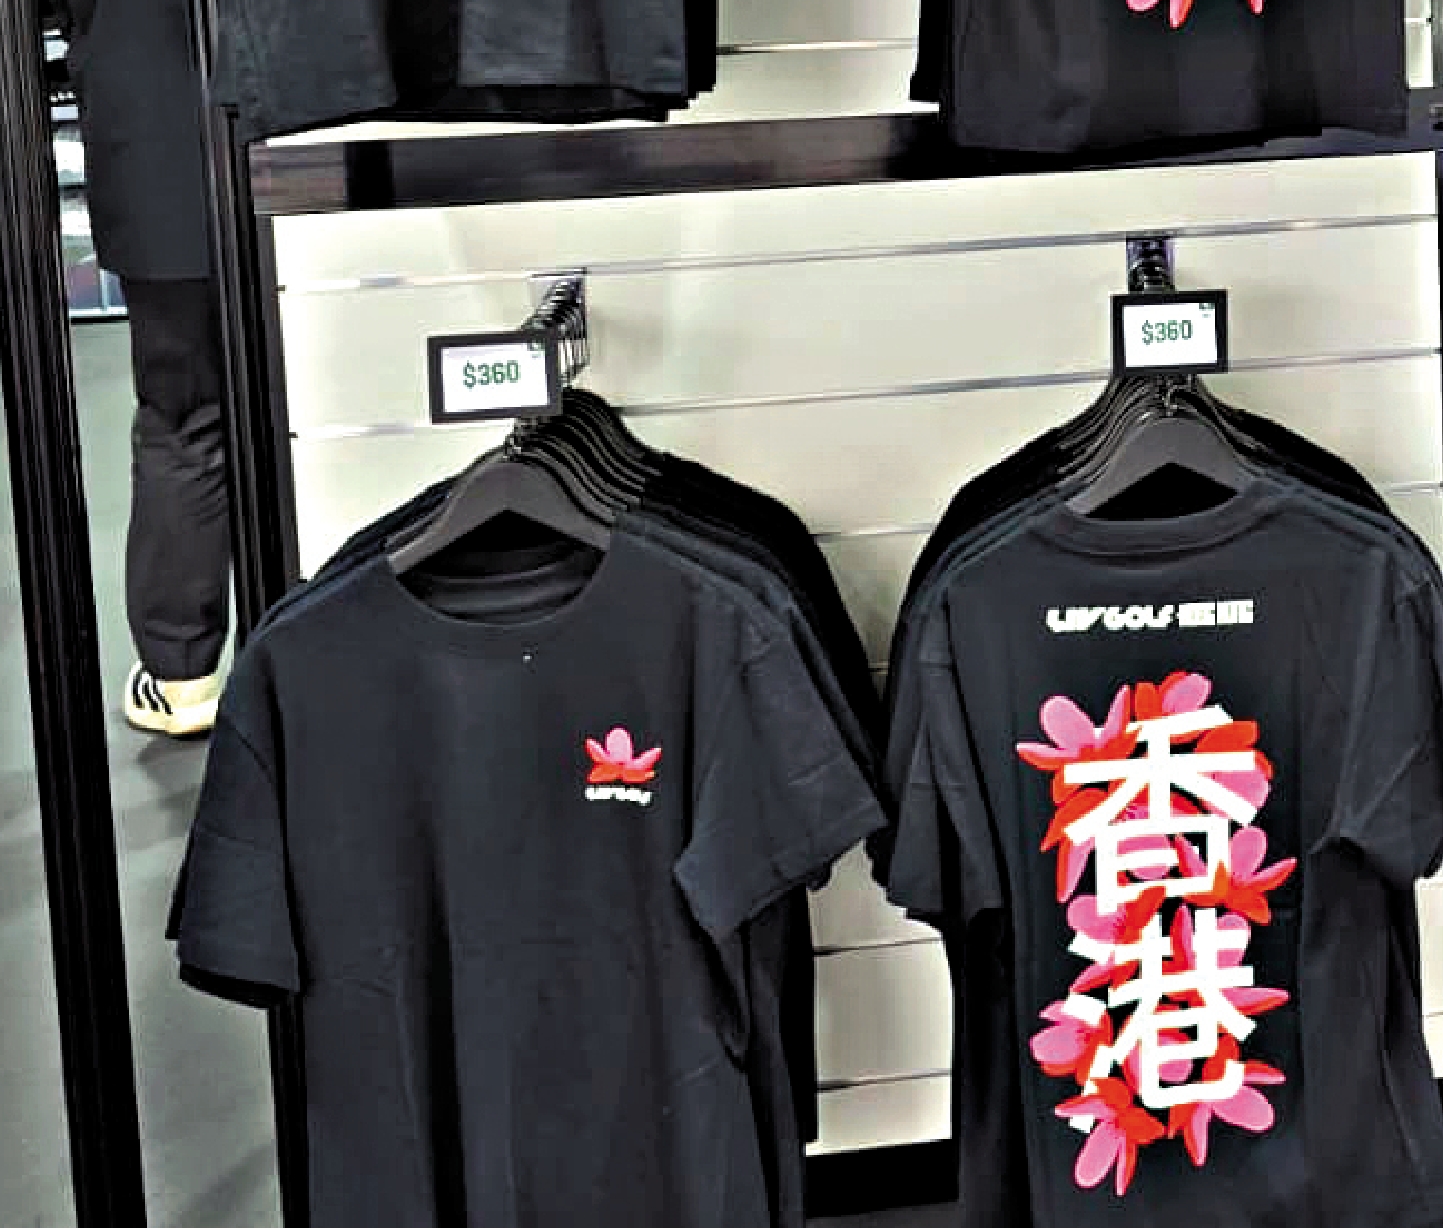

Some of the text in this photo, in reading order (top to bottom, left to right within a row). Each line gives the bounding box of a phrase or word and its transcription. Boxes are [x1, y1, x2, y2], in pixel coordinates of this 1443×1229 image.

[1142, 319, 1194, 346] $360
[463, 359, 521, 390] $360
[1062, 705, 1257, 1134] 香港
